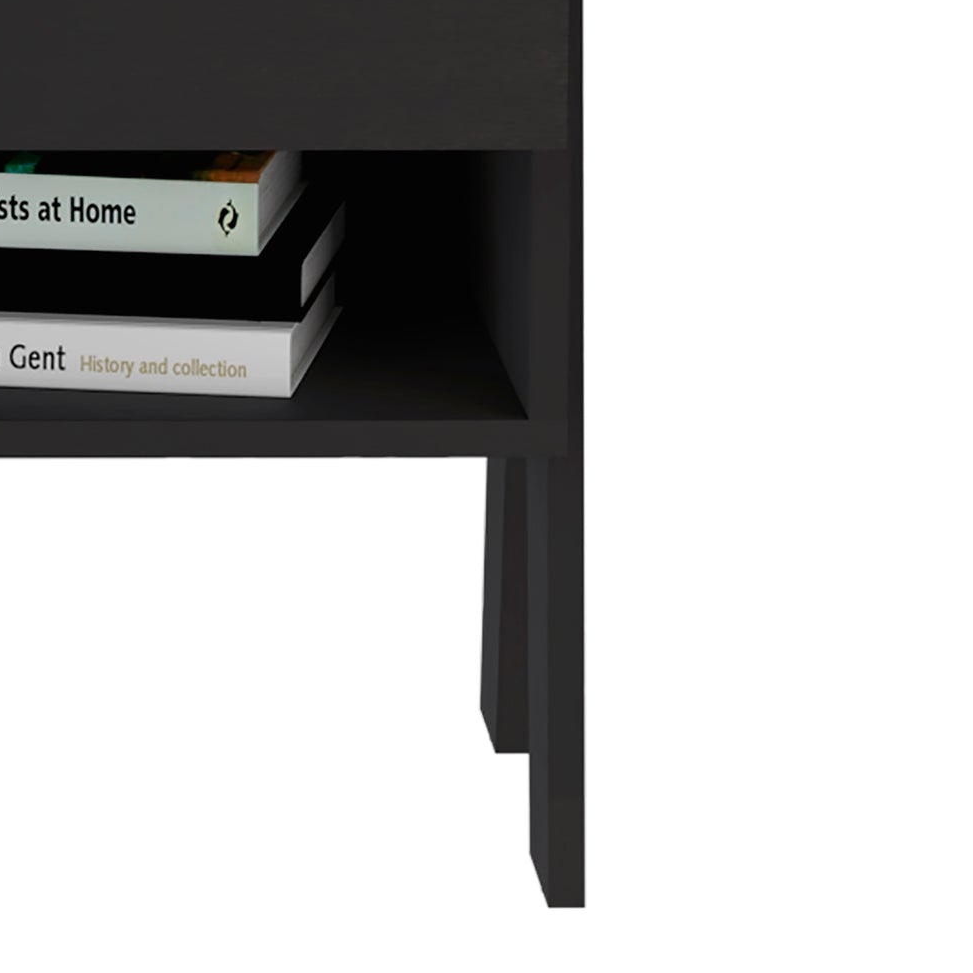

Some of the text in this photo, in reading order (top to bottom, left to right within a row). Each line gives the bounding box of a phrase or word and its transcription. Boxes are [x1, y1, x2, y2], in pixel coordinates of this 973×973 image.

[37, 196, 62, 223] at
[70, 196, 137, 225] Home
[9, 343, 66, 371] Gent
[79, 354, 247, 379] History and collection
